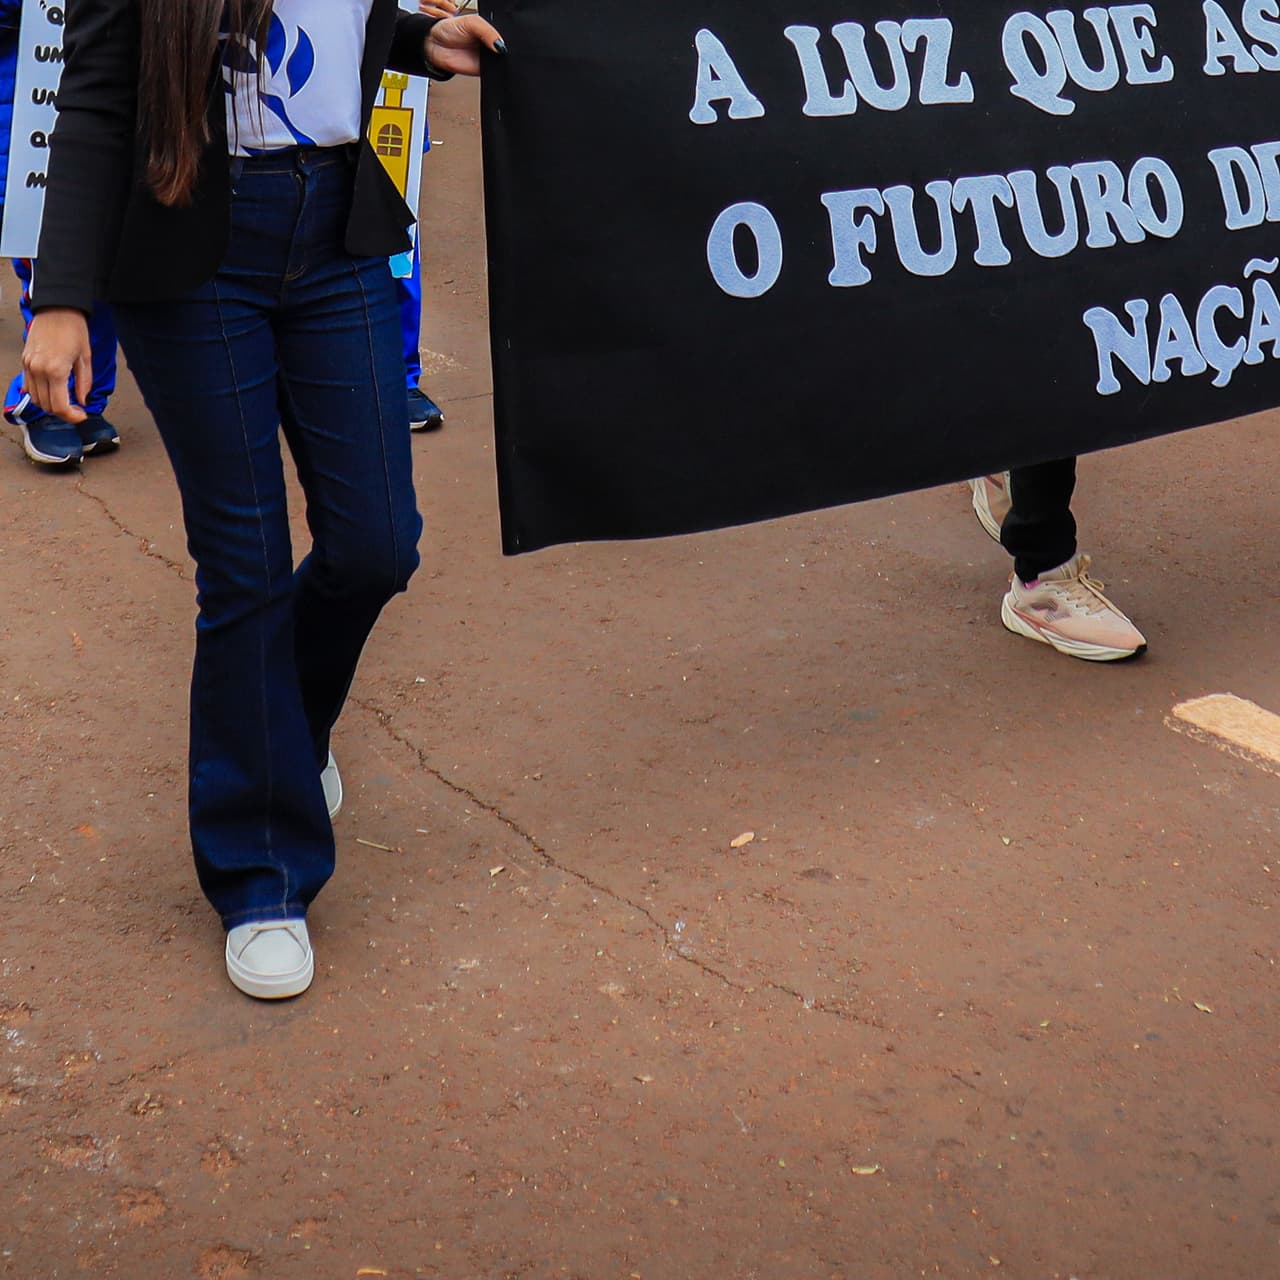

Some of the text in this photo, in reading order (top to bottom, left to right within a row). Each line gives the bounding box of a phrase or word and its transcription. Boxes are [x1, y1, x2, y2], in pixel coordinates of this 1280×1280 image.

[688, 27, 766, 126] A
[783, 16, 976, 118] LUZ
[1001, 2, 1175, 116] QUE
[705, 200, 784, 300] O
[820, 155, 1185, 288] FUTURO
